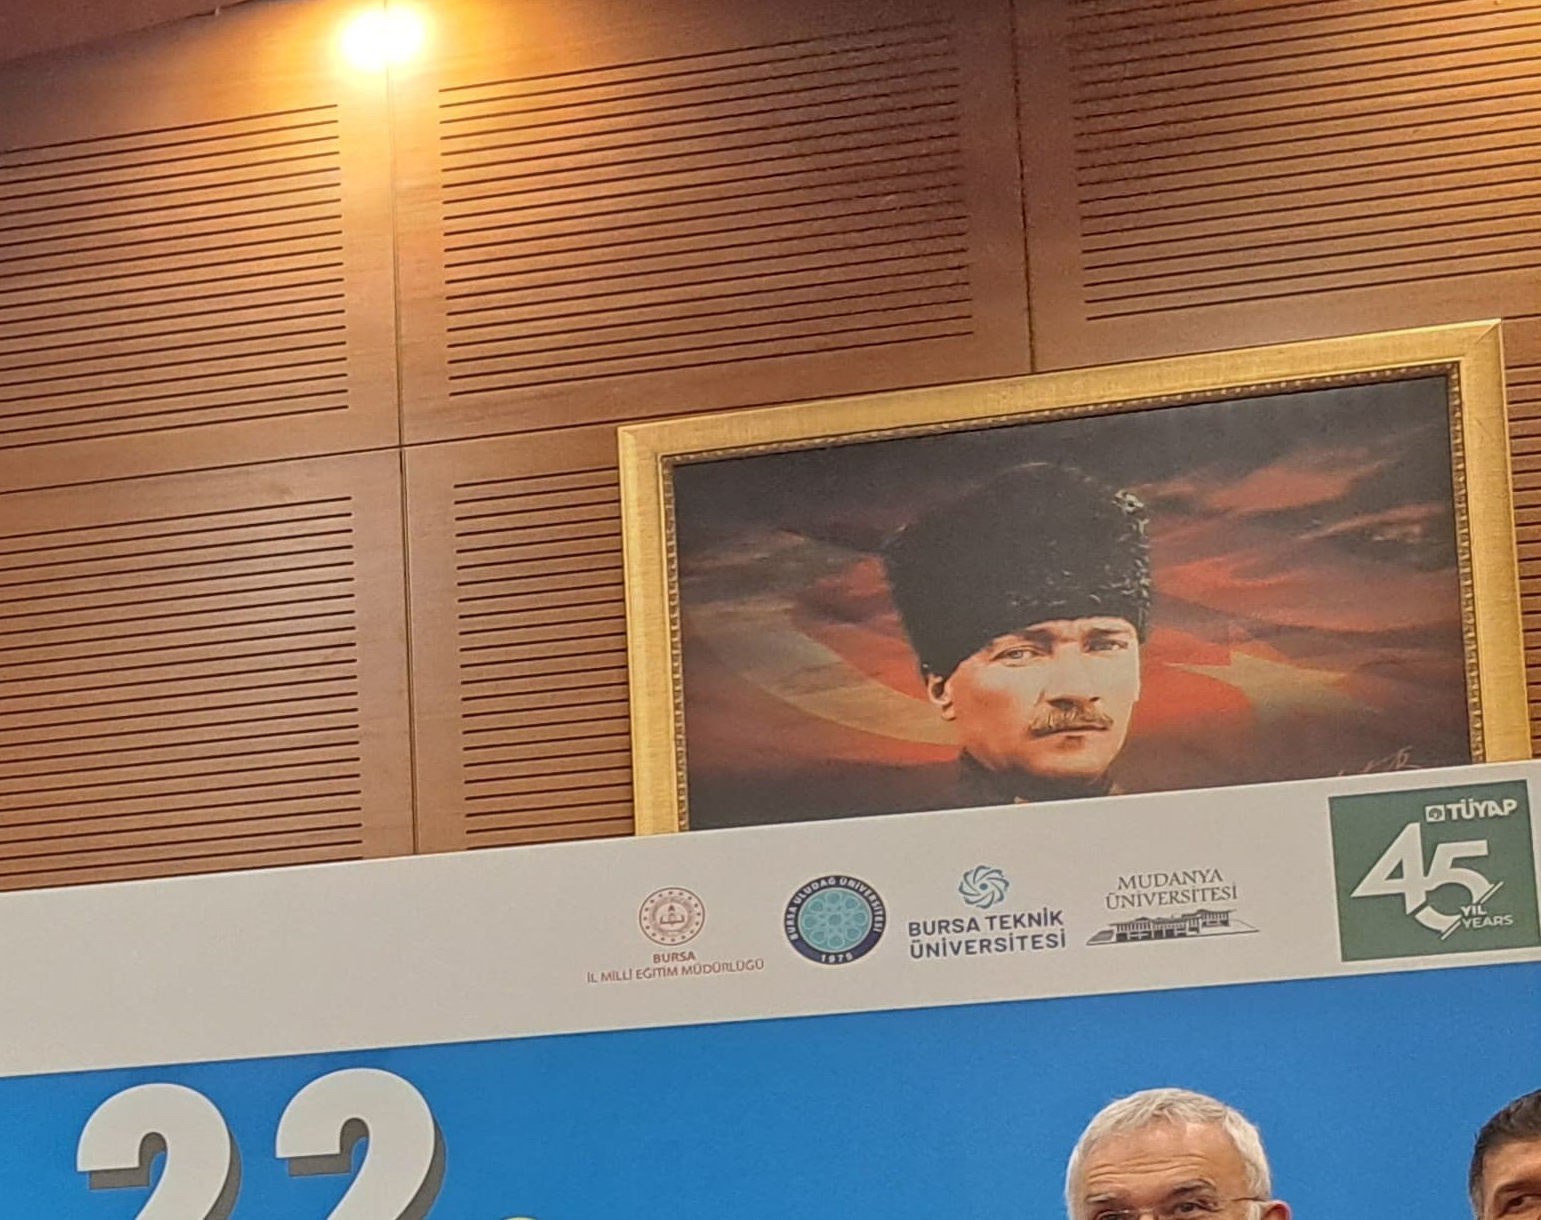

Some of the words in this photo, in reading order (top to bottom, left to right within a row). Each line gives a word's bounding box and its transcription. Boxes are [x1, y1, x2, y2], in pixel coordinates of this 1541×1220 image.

[1446, 797, 1518, 822] TÜYAP
[1116, 868, 1225, 891] MUDANYA
[1105, 885, 1239, 910] ÜNİVERSİTESİ
[908, 918, 981, 938] BURSA
[985, 907, 1064, 932] TEKNİK
[1462, 914, 1514, 928] YEARS
[909, 928, 1066, 960] ÜNİVERSİTESİ
[652, 951, 696, 964] BURSA
